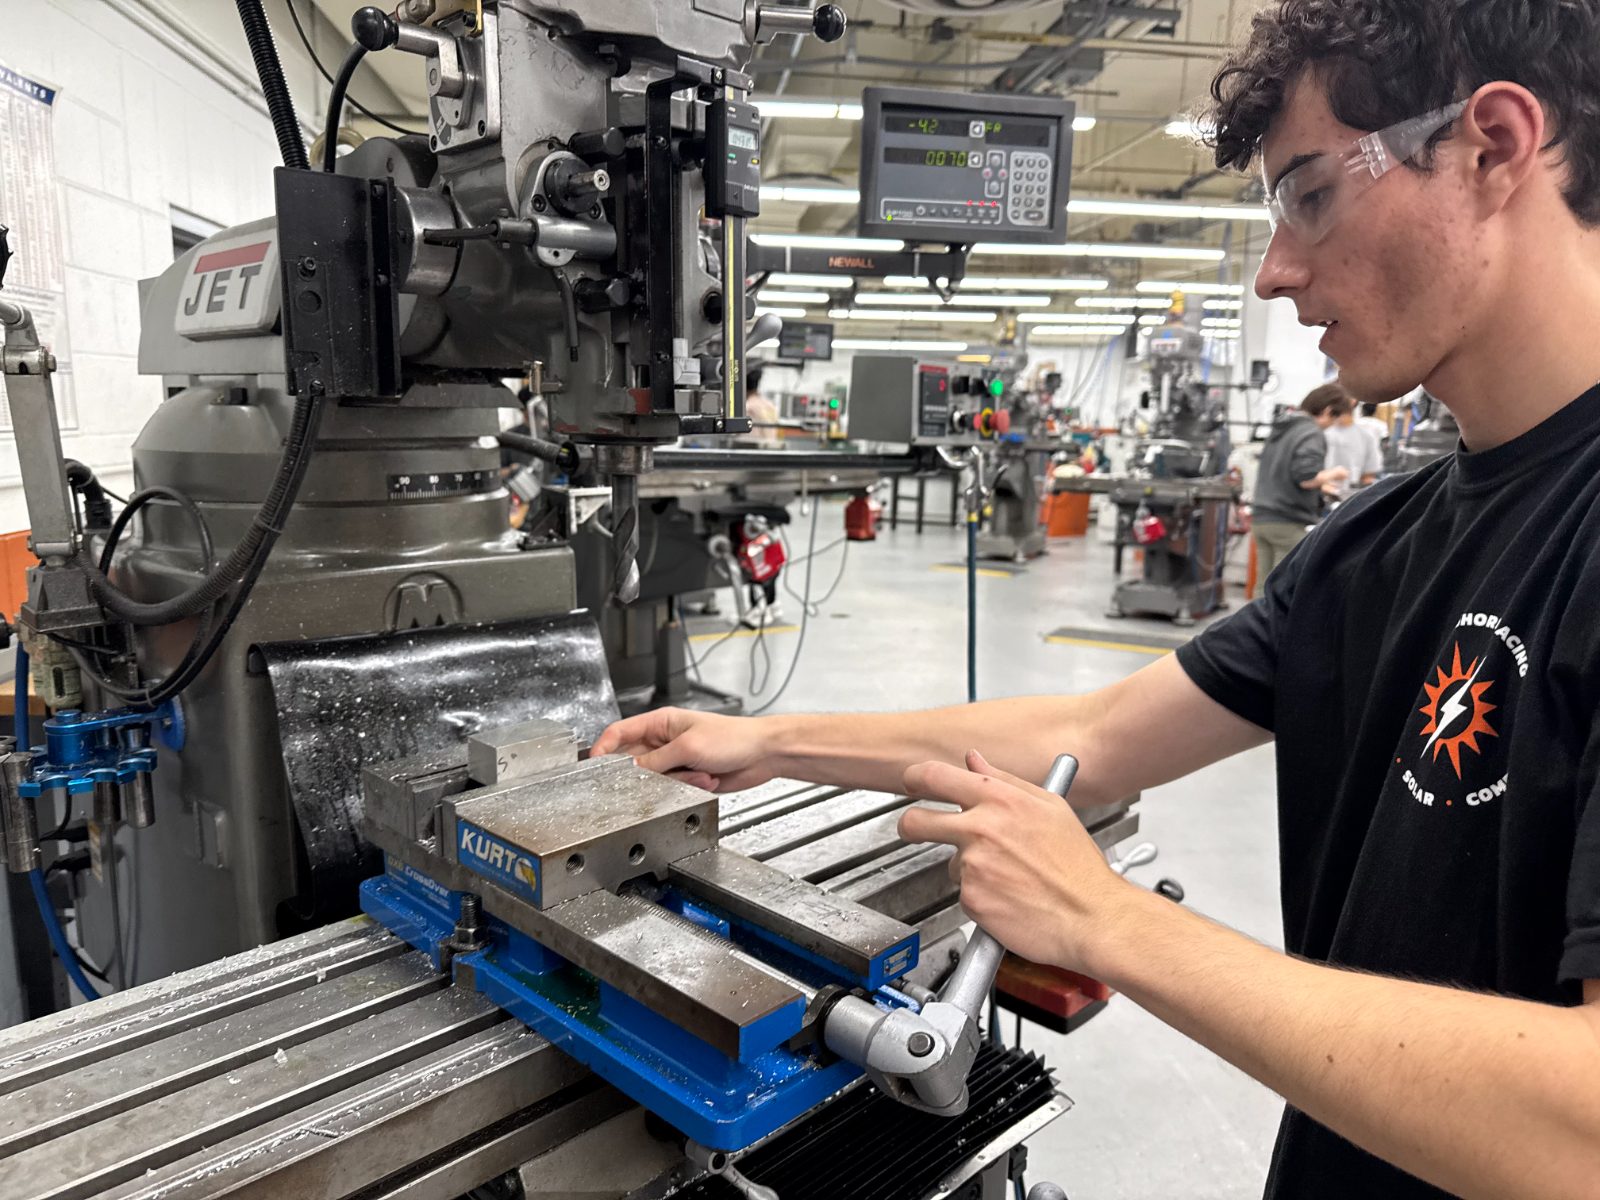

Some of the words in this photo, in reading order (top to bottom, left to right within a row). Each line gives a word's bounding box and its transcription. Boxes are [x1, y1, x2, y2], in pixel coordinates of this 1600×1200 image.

[828, 256, 875, 269] NEWALL
[184, 264, 263, 316] JET
[1456, 613, 1502, 629] HOR
[1494, 625, 1529, 678] ACING
[1402, 769, 1435, 807] SOLAR
[461, 828, 518, 873] KURT
